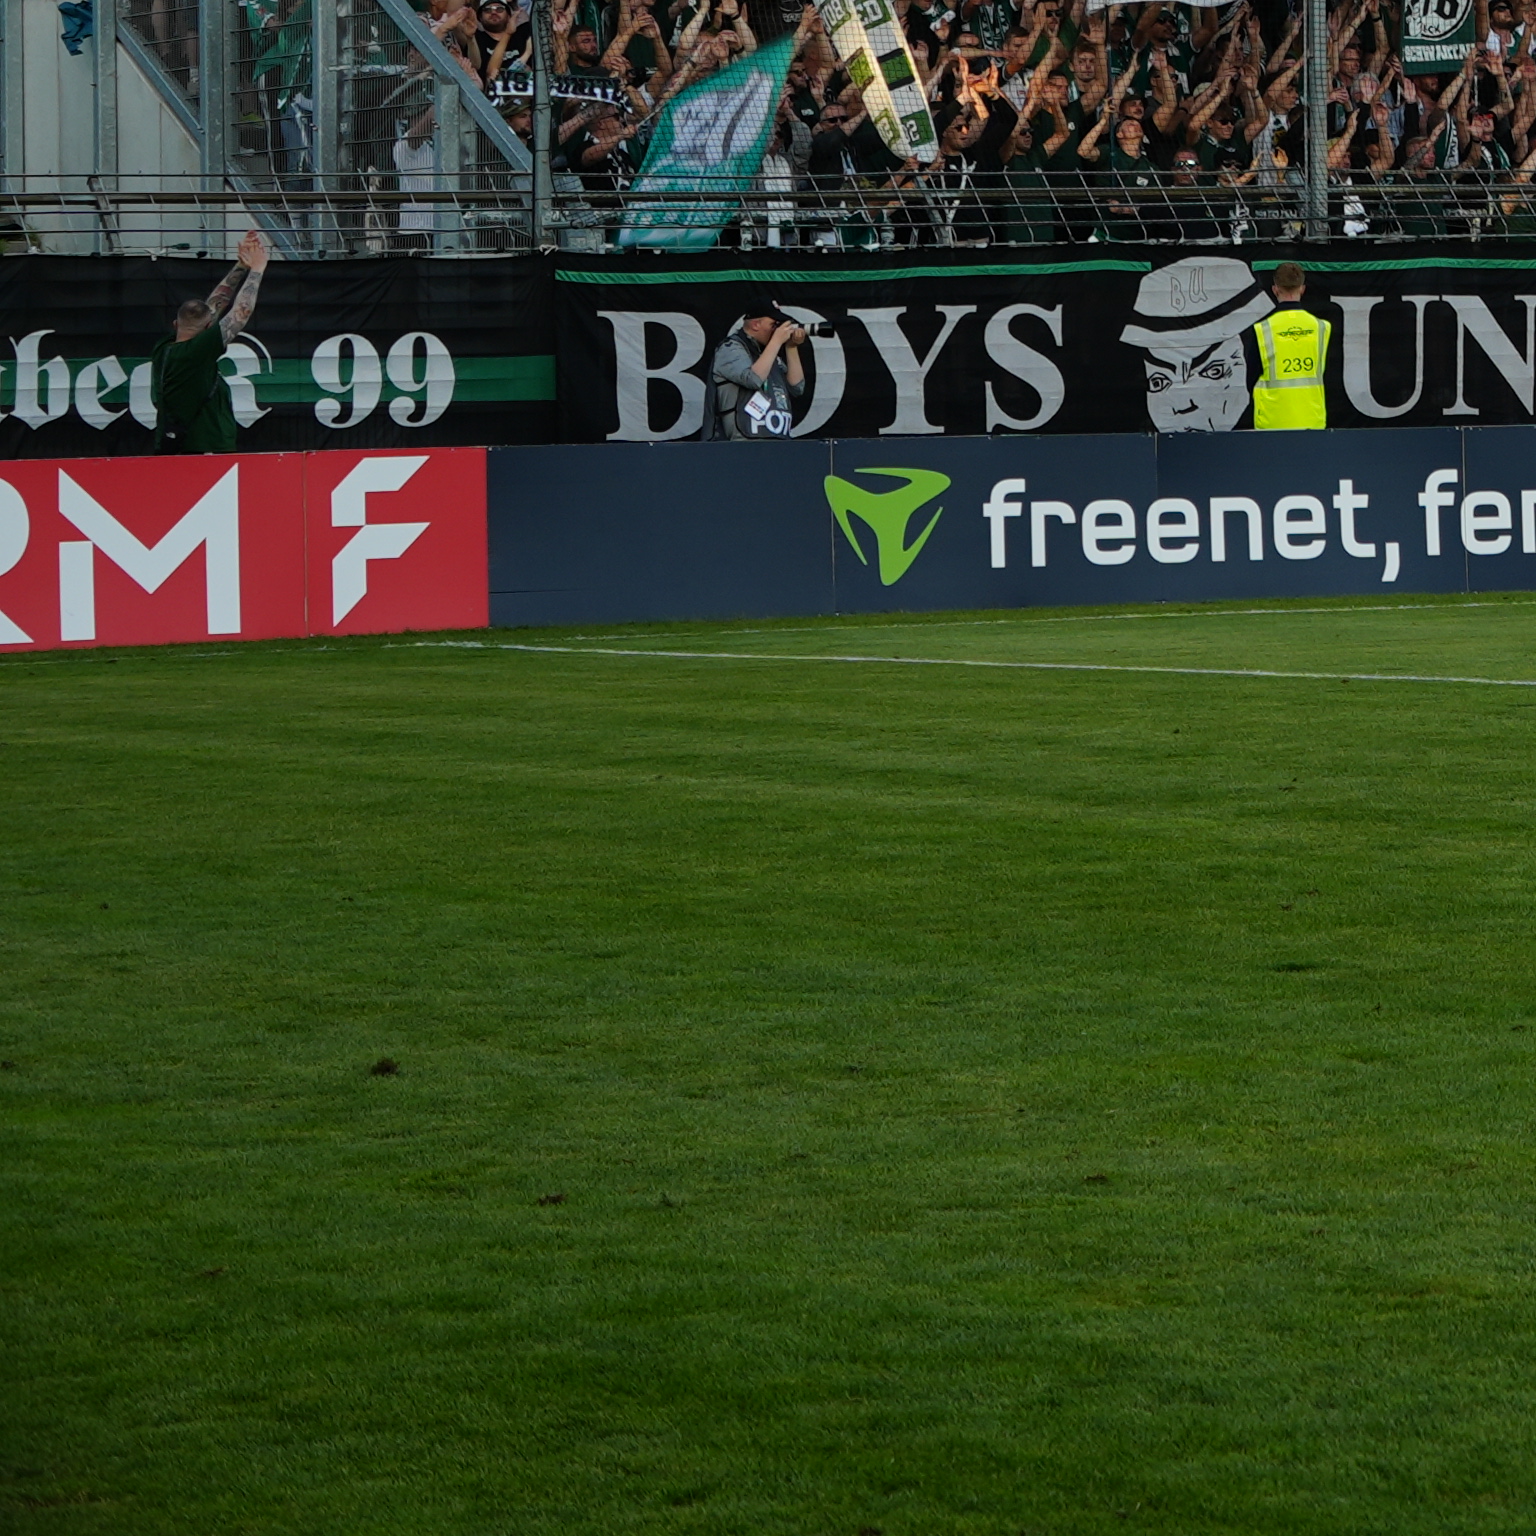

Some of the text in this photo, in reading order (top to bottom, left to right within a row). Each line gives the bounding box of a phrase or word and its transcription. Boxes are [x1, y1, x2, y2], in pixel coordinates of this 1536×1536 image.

[311, 331, 456, 429] 99
[597, 304, 1064, 442] BOYS
[1282, 357, 1314, 373] 239
[983, 478, 1400, 582] freenet,
